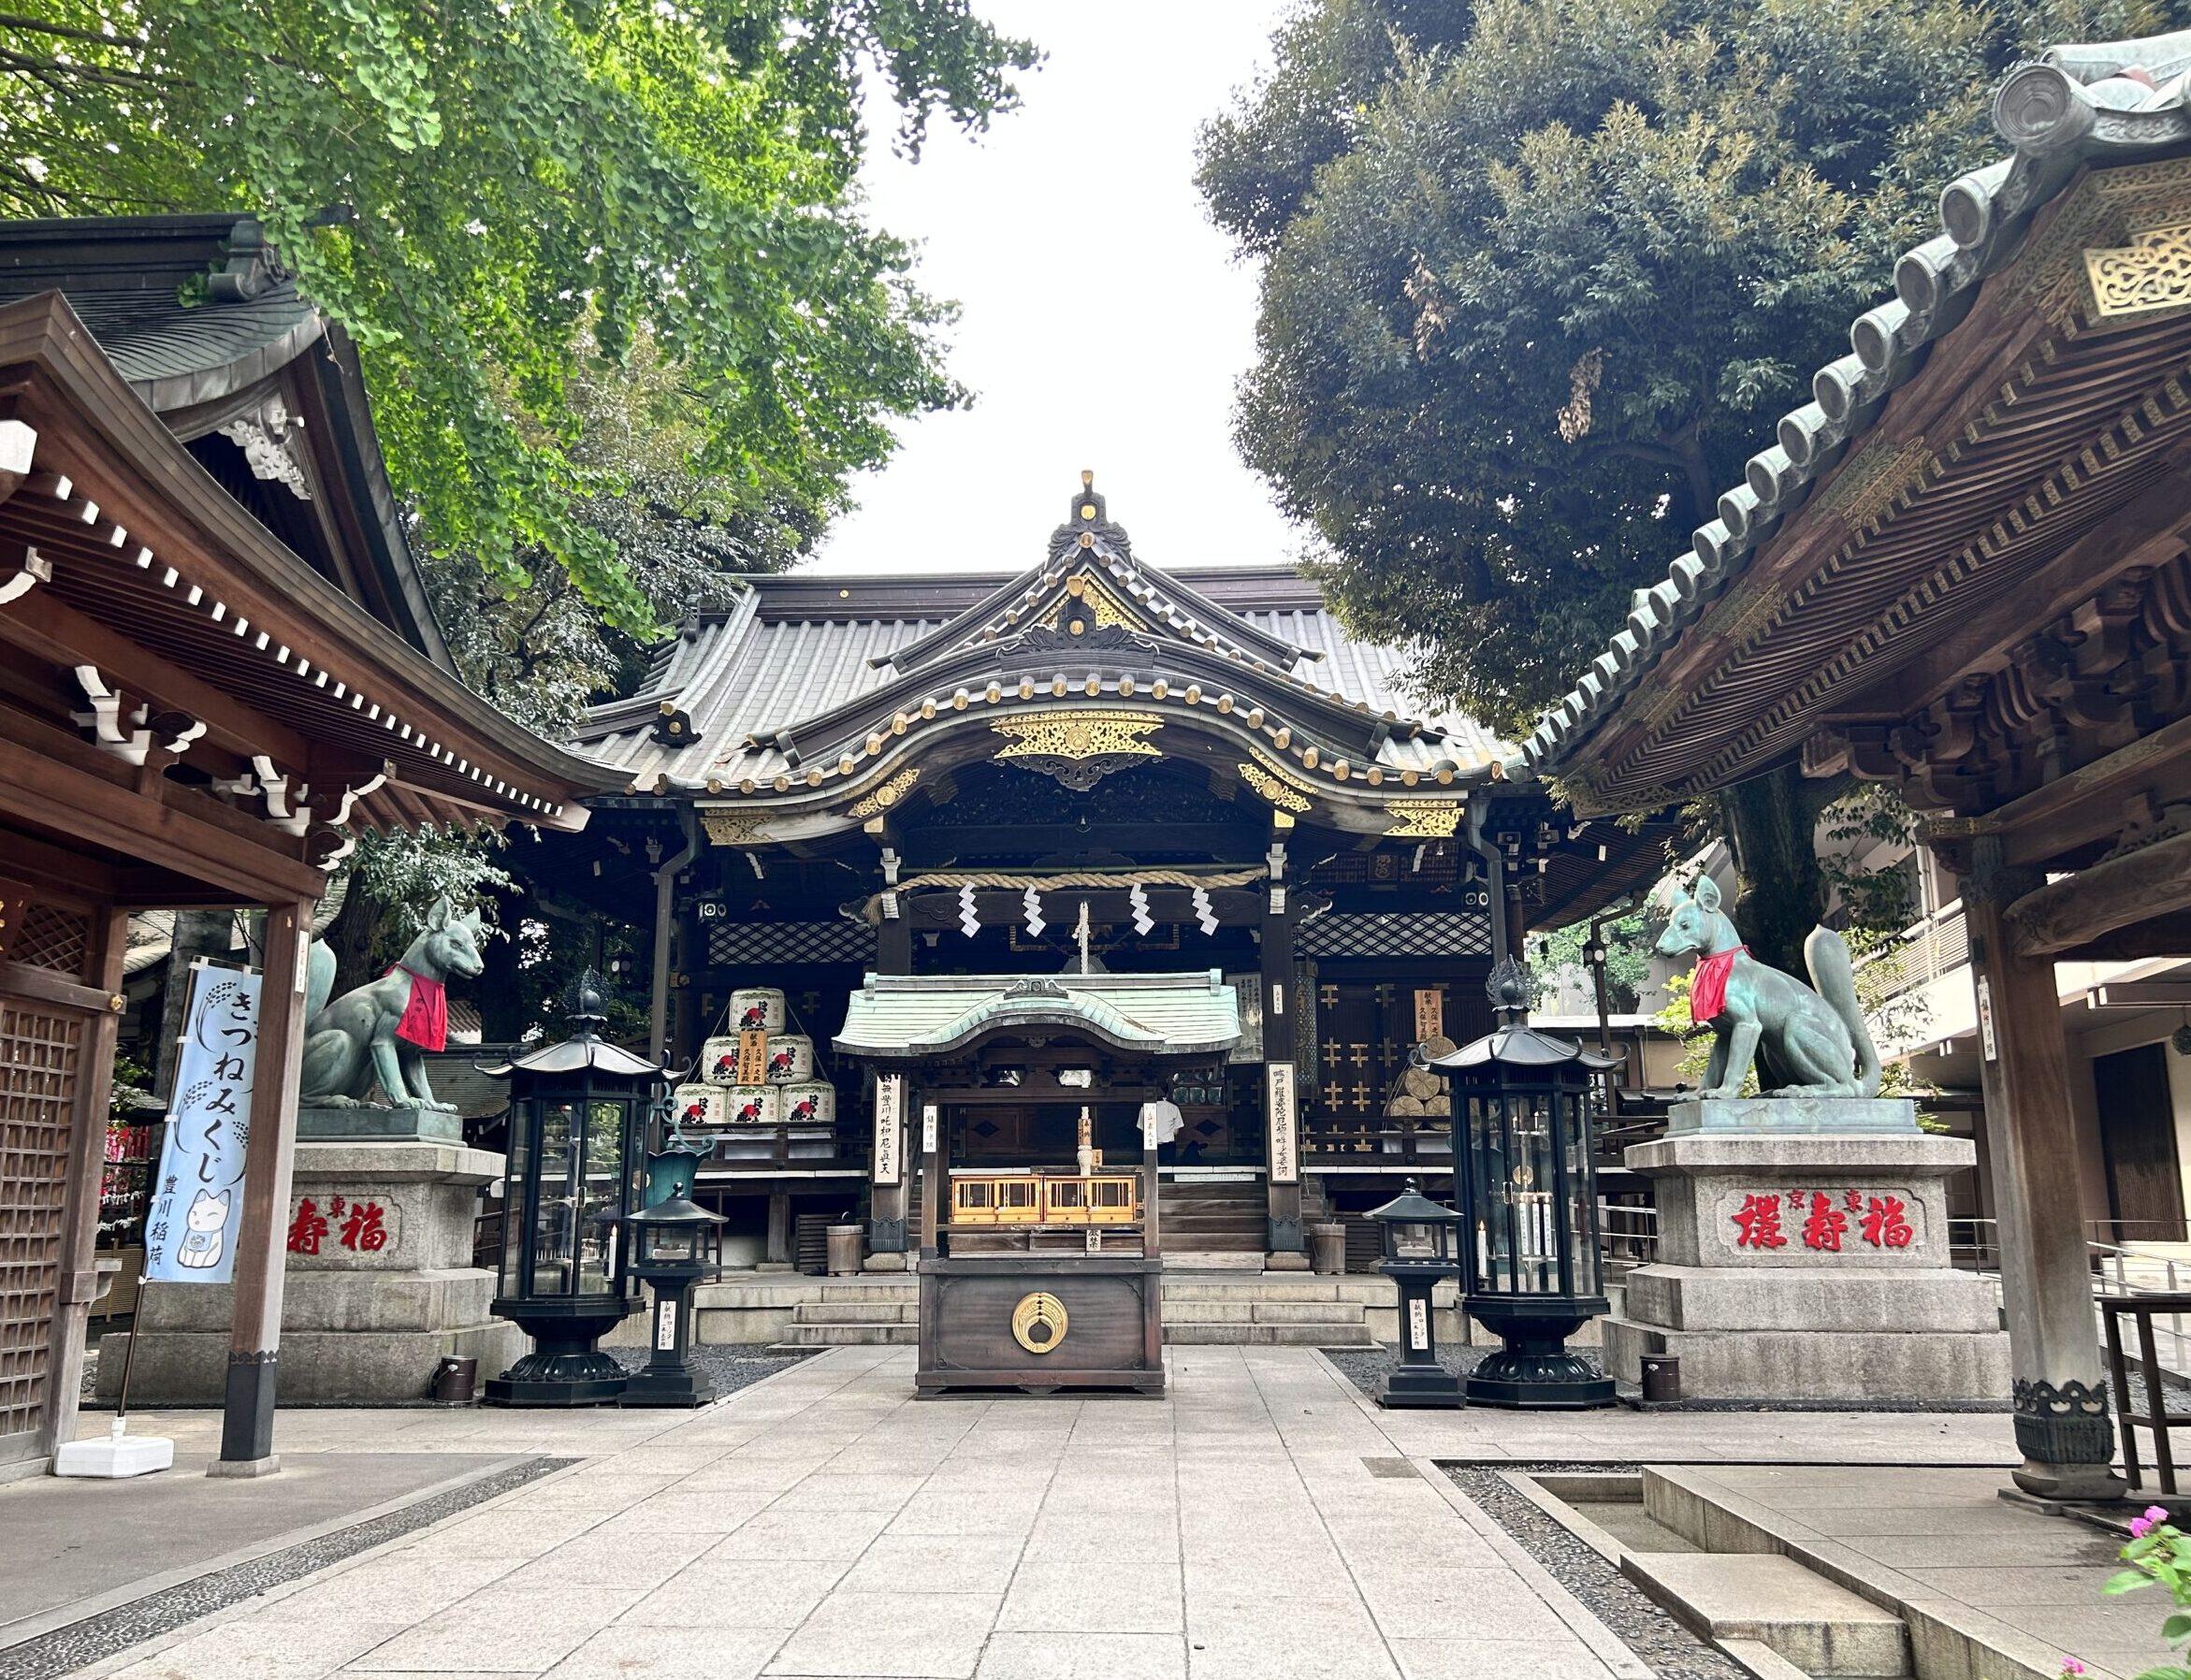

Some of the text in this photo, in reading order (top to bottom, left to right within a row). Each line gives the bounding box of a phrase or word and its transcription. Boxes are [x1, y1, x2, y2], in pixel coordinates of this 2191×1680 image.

[198, 992, 253, 1183] きつねみくじ
[149, 1174, 179, 1266] 豊川稲荷
